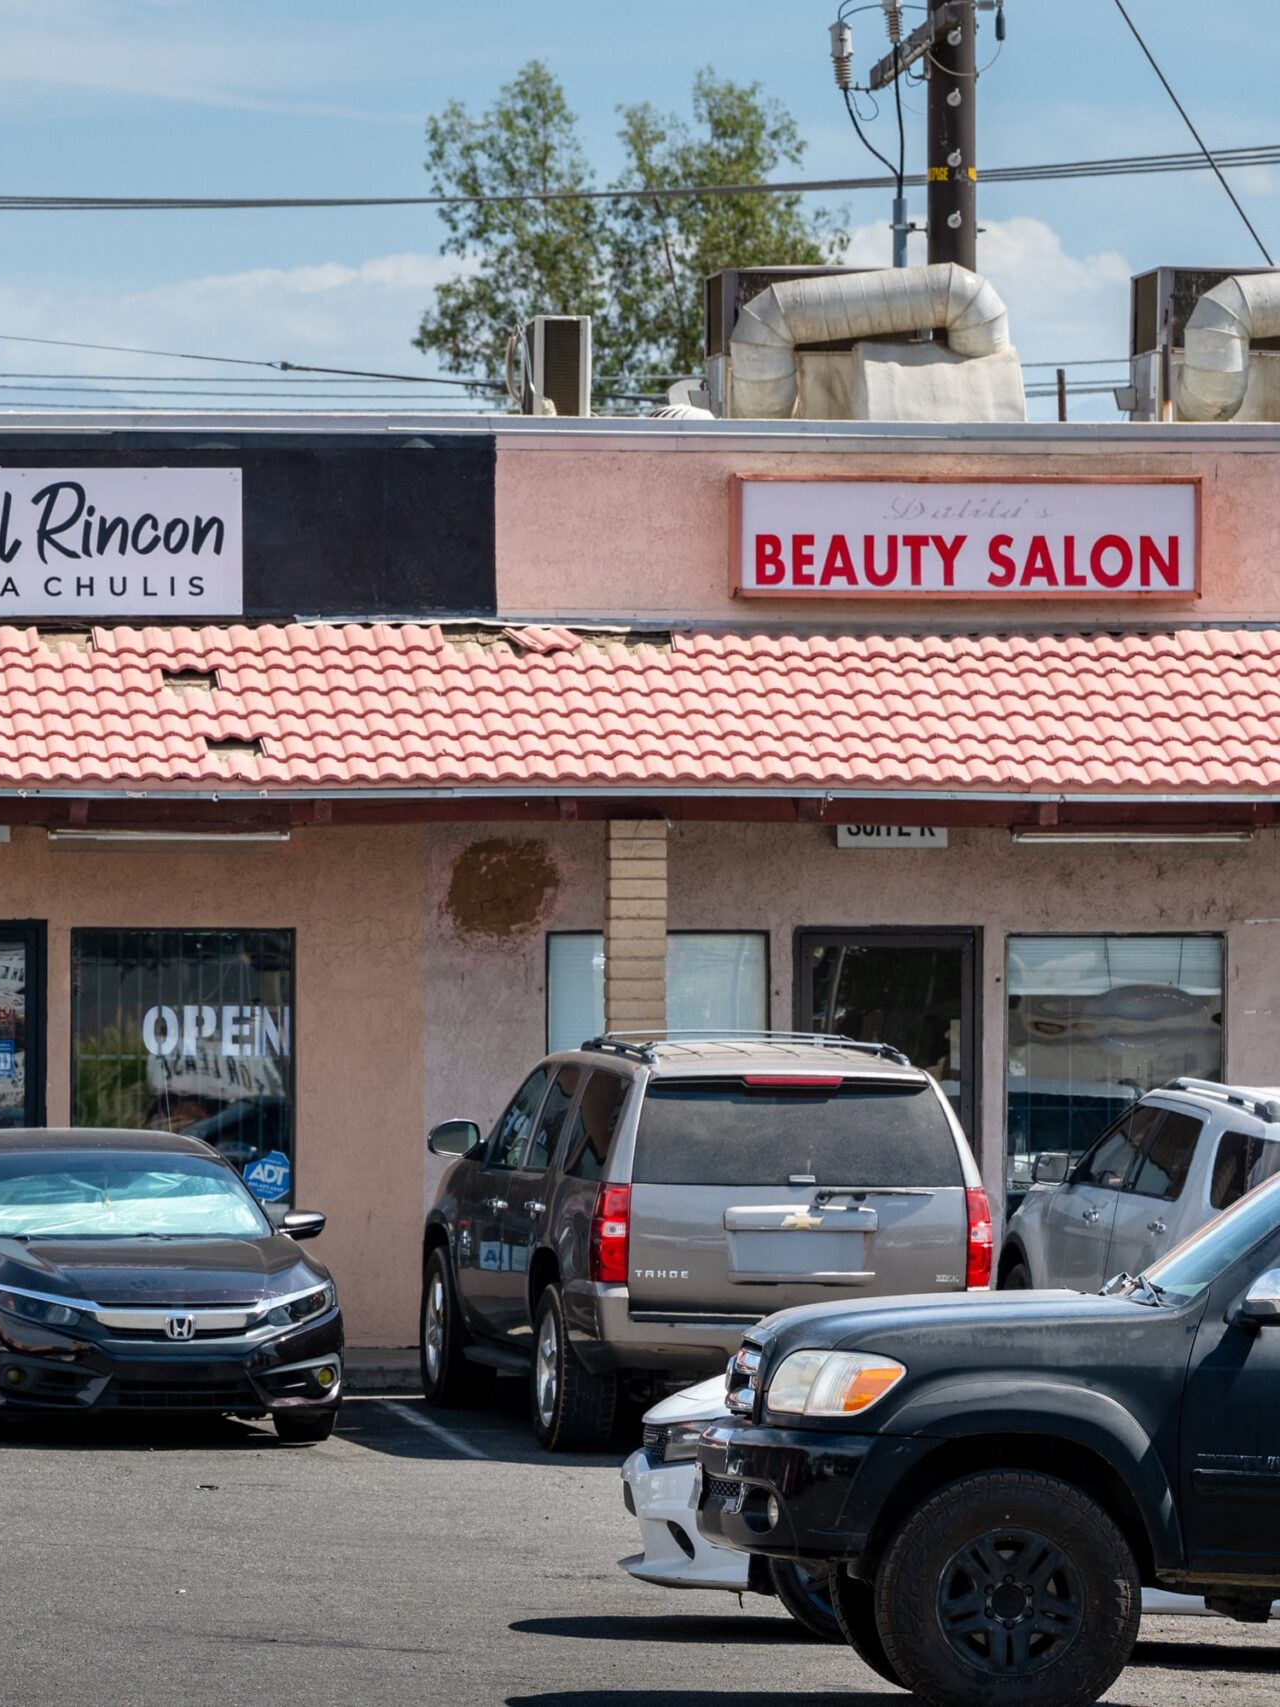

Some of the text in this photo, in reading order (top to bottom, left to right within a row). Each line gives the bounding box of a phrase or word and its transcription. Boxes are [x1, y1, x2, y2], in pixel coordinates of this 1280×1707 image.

[31, 481, 224, 565] Rincon
[755, 533, 1180, 588] BEAUTY SALON
[43, 575, 206, 598] CHULIS
[142, 1005, 290, 1056] OPEN
[248, 1163, 290, 1186] ADT
[634, 1269, 689, 1279] TAHOE
